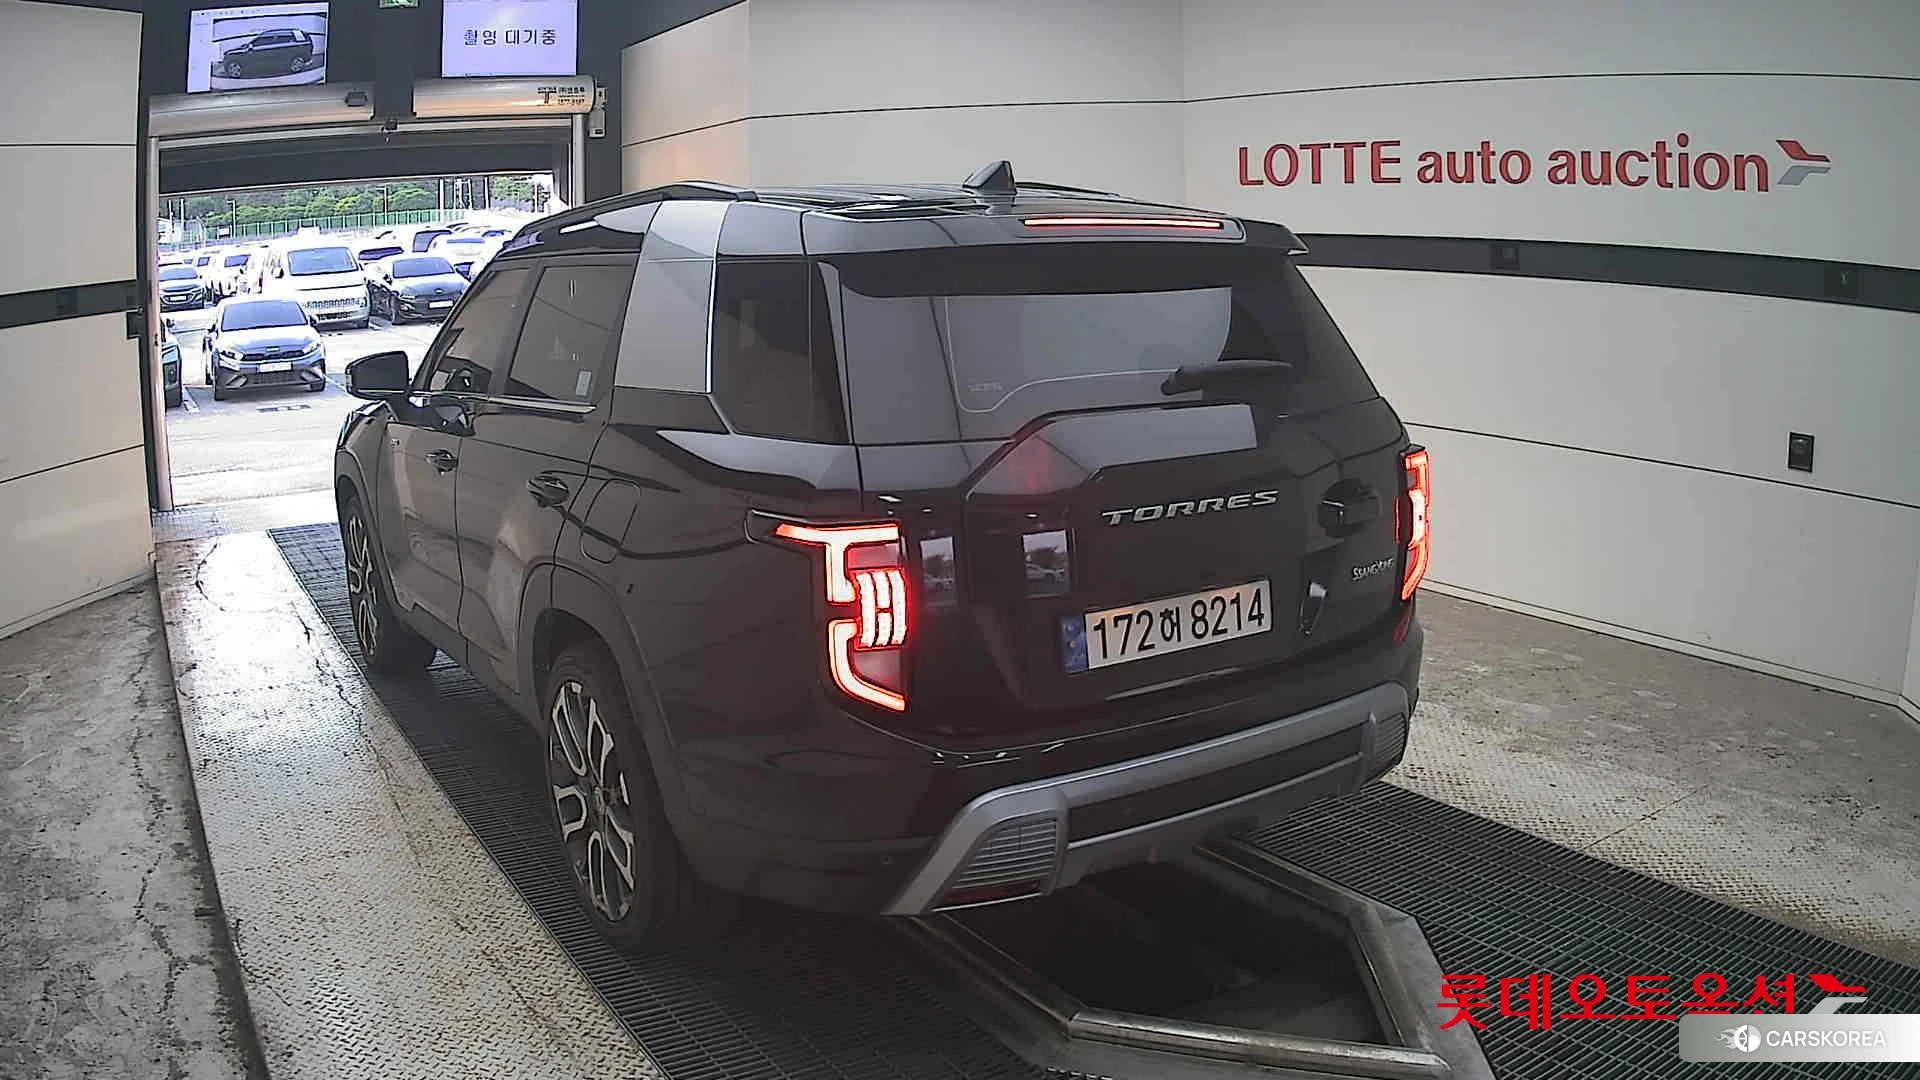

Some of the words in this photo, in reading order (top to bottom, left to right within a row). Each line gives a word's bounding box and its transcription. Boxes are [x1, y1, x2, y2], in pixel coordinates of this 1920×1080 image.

[505, 29, 556, 46] 대기중
[1239, 139, 1401, 187] LOTTE
[1416, 140, 1532, 185] auto
[1547, 132, 1770, 193] auction
[1102, 490, 1280, 526] TORRES
[1093, 608, 1182, 659] 172허
[1191, 588, 1265, 640] 8214
